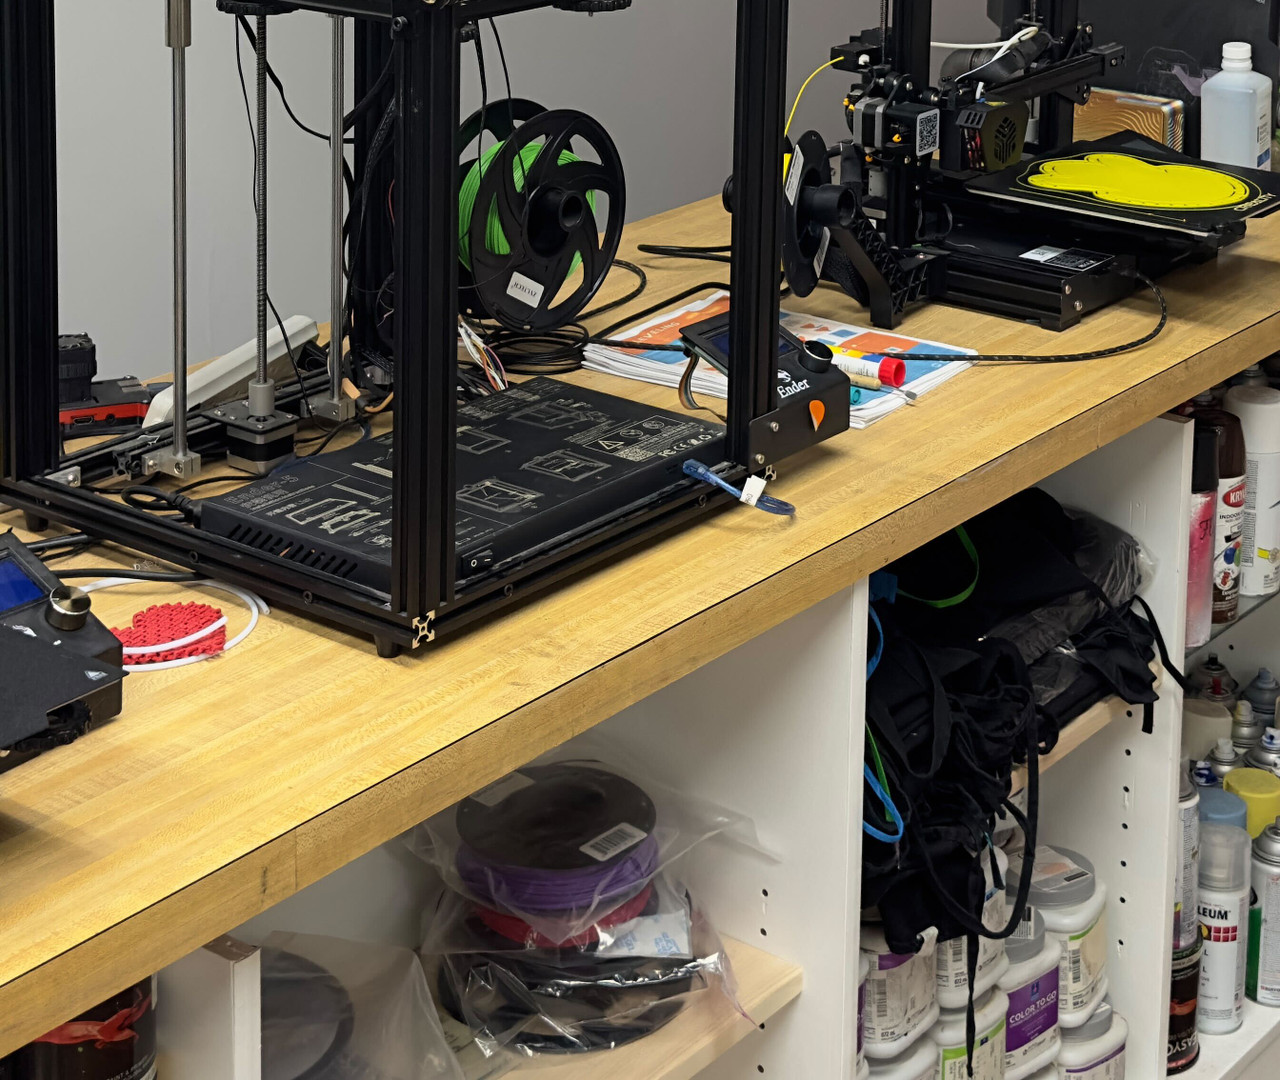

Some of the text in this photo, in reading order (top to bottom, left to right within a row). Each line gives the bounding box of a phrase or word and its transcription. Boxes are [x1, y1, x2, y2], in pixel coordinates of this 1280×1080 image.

[776, 379, 810, 399] Ender
[1010, 990, 1057, 1023] COLOR TO GO
